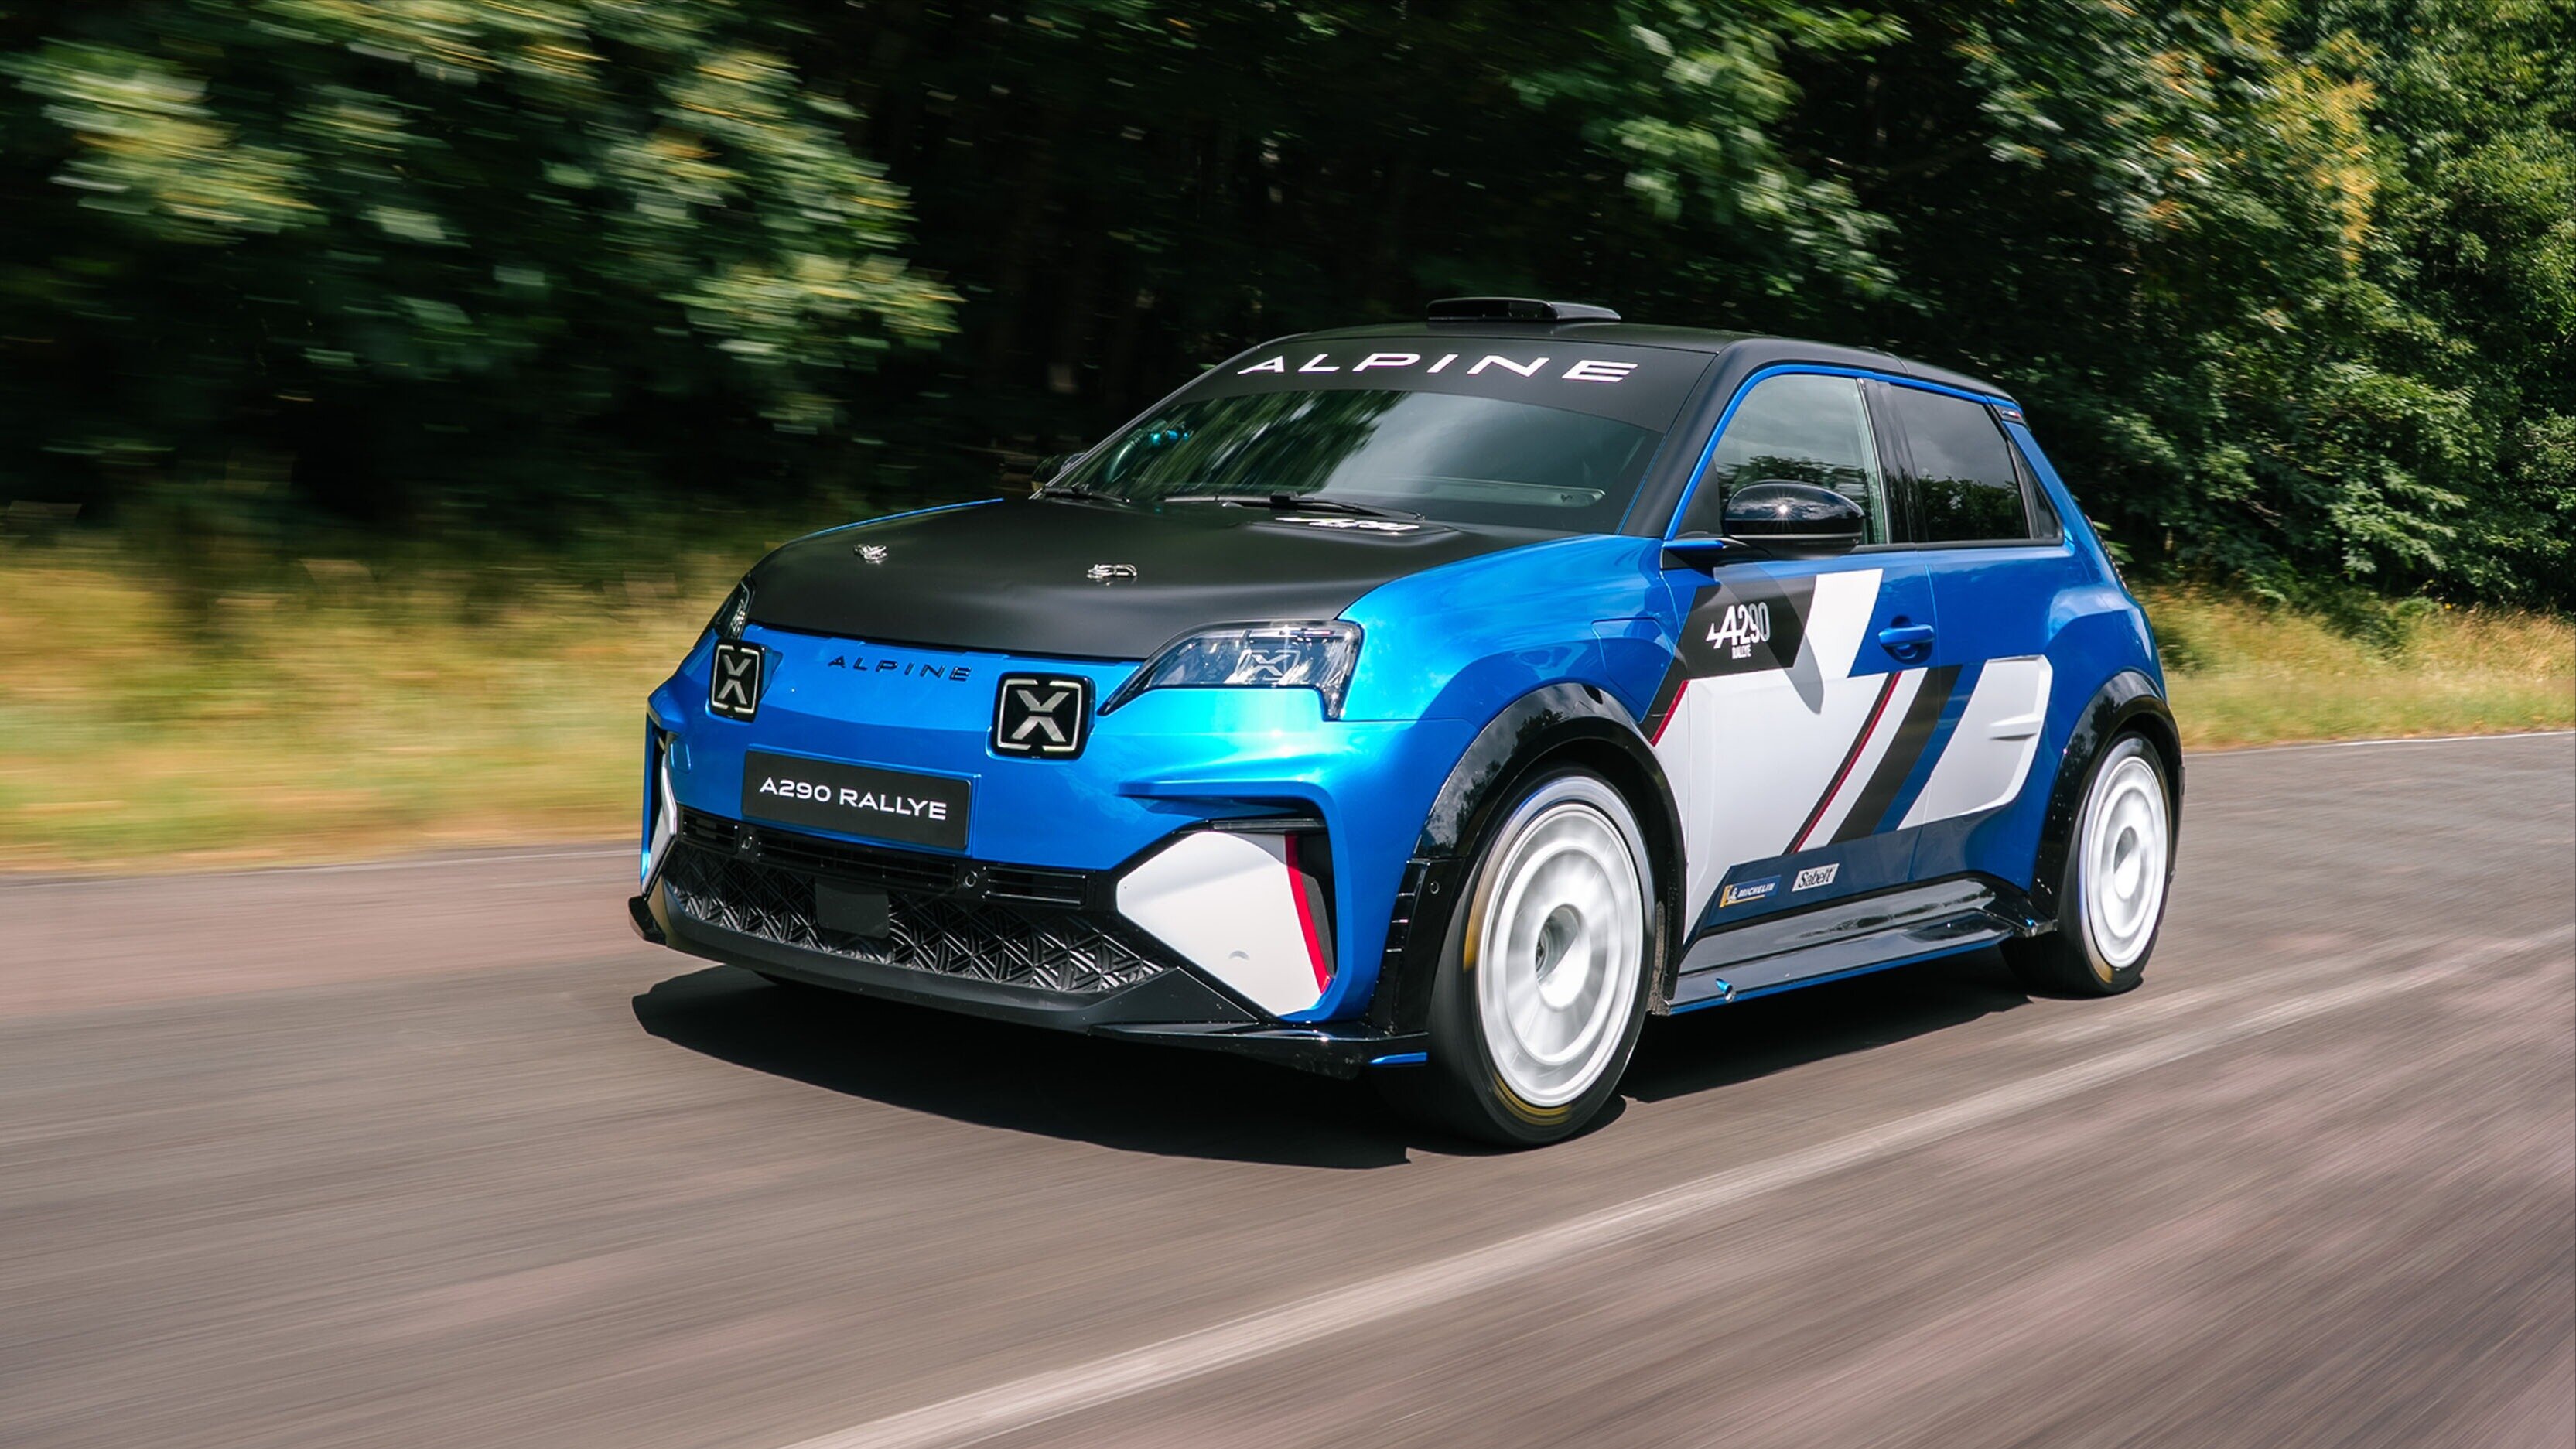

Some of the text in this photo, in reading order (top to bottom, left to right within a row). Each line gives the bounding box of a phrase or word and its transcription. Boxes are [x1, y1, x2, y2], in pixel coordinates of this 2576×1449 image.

[1237, 353, 1638, 382] ALPINE
[1706, 602, 1770, 648] A290
[828, 655, 972, 682] ALPINE
[759, 777, 947, 821] A290 RALLYE
[1738, 883, 1775, 897] MICHELIN
[1798, 867, 1833, 888] Sabelt
